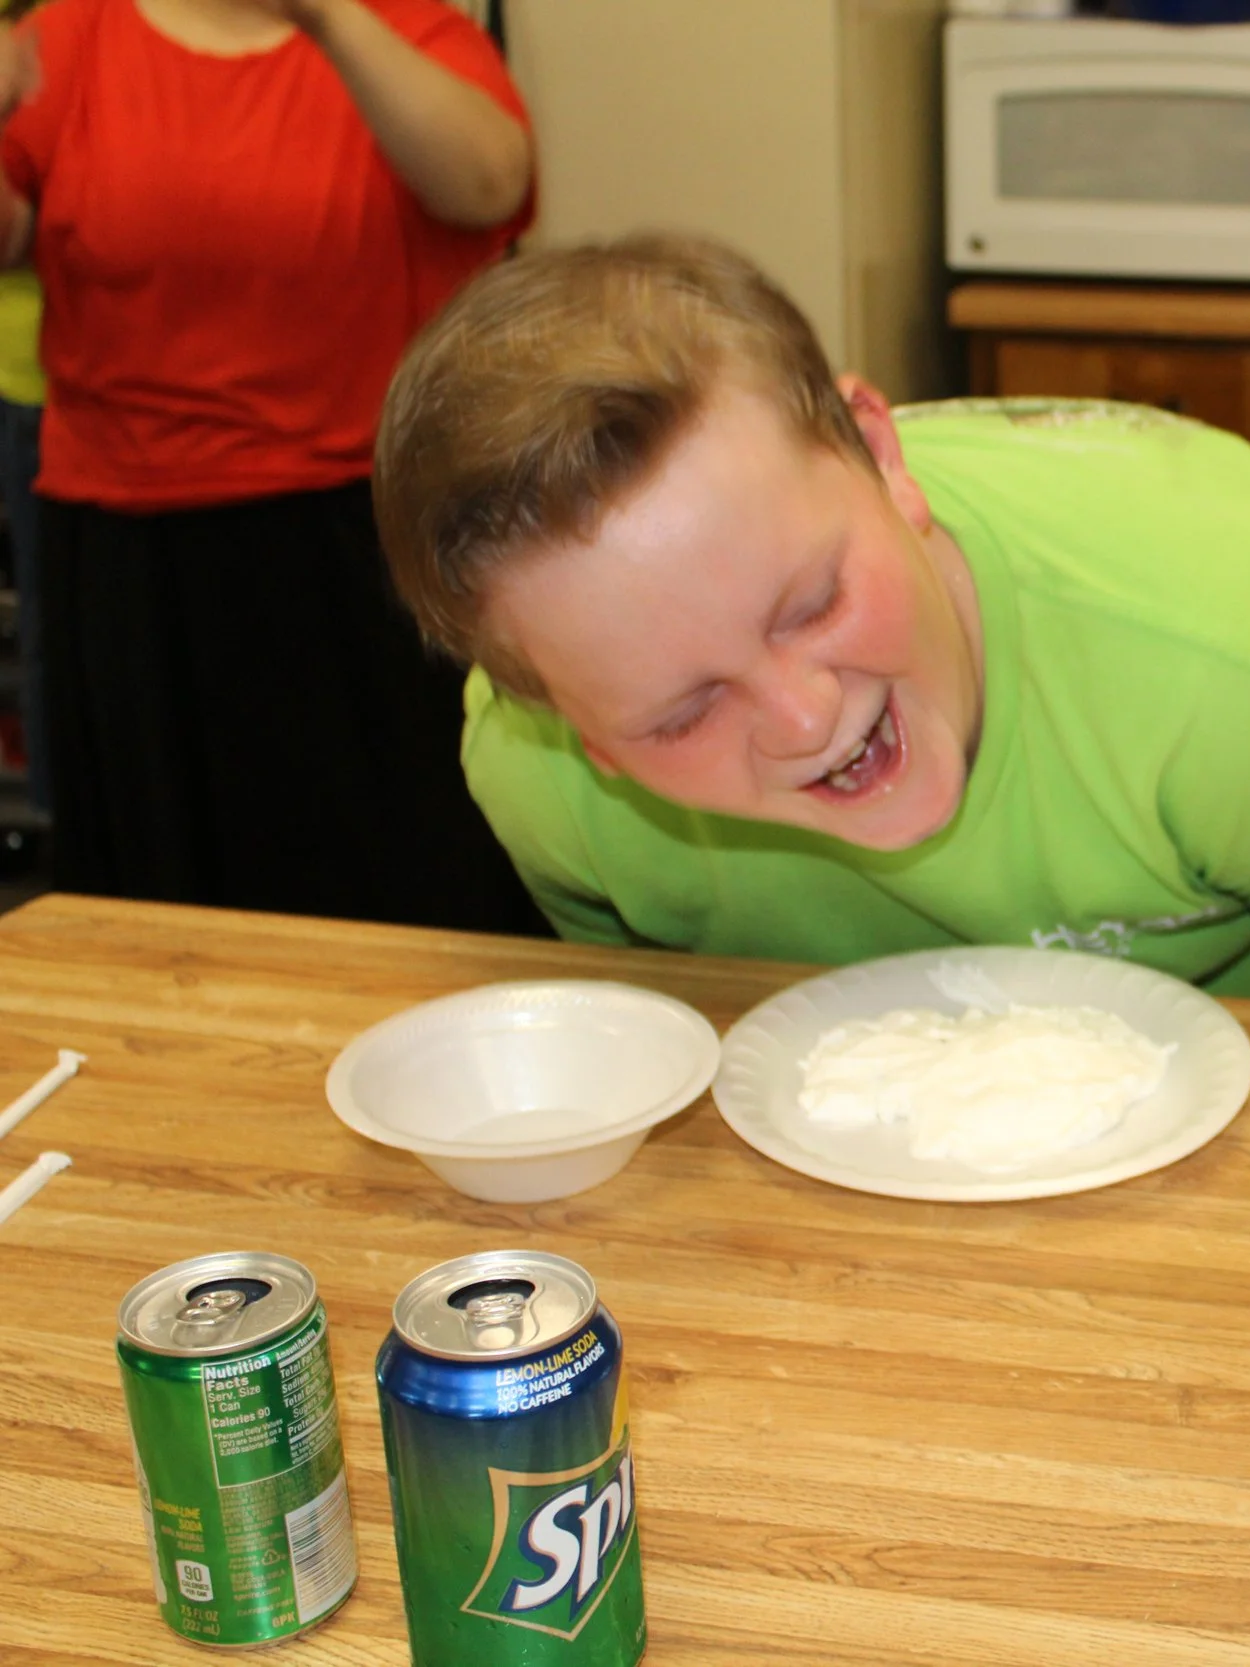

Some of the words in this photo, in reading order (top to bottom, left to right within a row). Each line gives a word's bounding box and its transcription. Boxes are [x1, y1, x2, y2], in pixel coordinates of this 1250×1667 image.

[205, 1355, 272, 1380] Nutrition
[496, 1347, 575, 1386] LEMON-LIME
[572, 1330, 598, 1358] SODA
[280, 1360, 300, 1379] Total
[497, 1383, 529, 1401] 100%
[529, 1367, 576, 1394] NATURAL
[573, 1342, 606, 1375] FLAVORS
[206, 1377, 249, 1392] Facts
[282, 1371, 310, 1394] Sodium
[207, 1391, 237, 1403] Serv.
[239, 1385, 261, 1398] Size
[284, 1390, 304, 1408] Total
[498, 1400, 519, 1415] NO
[520, 1382, 573, 1410] CAFFEINE
[209, 1404, 216, 1413] 1
[219, 1401, 240, 1413] Can
[211, 1413, 256, 1429] Calories
[256, 1406, 271, 1419] 90
[184, 1565, 202, 1582] 90
